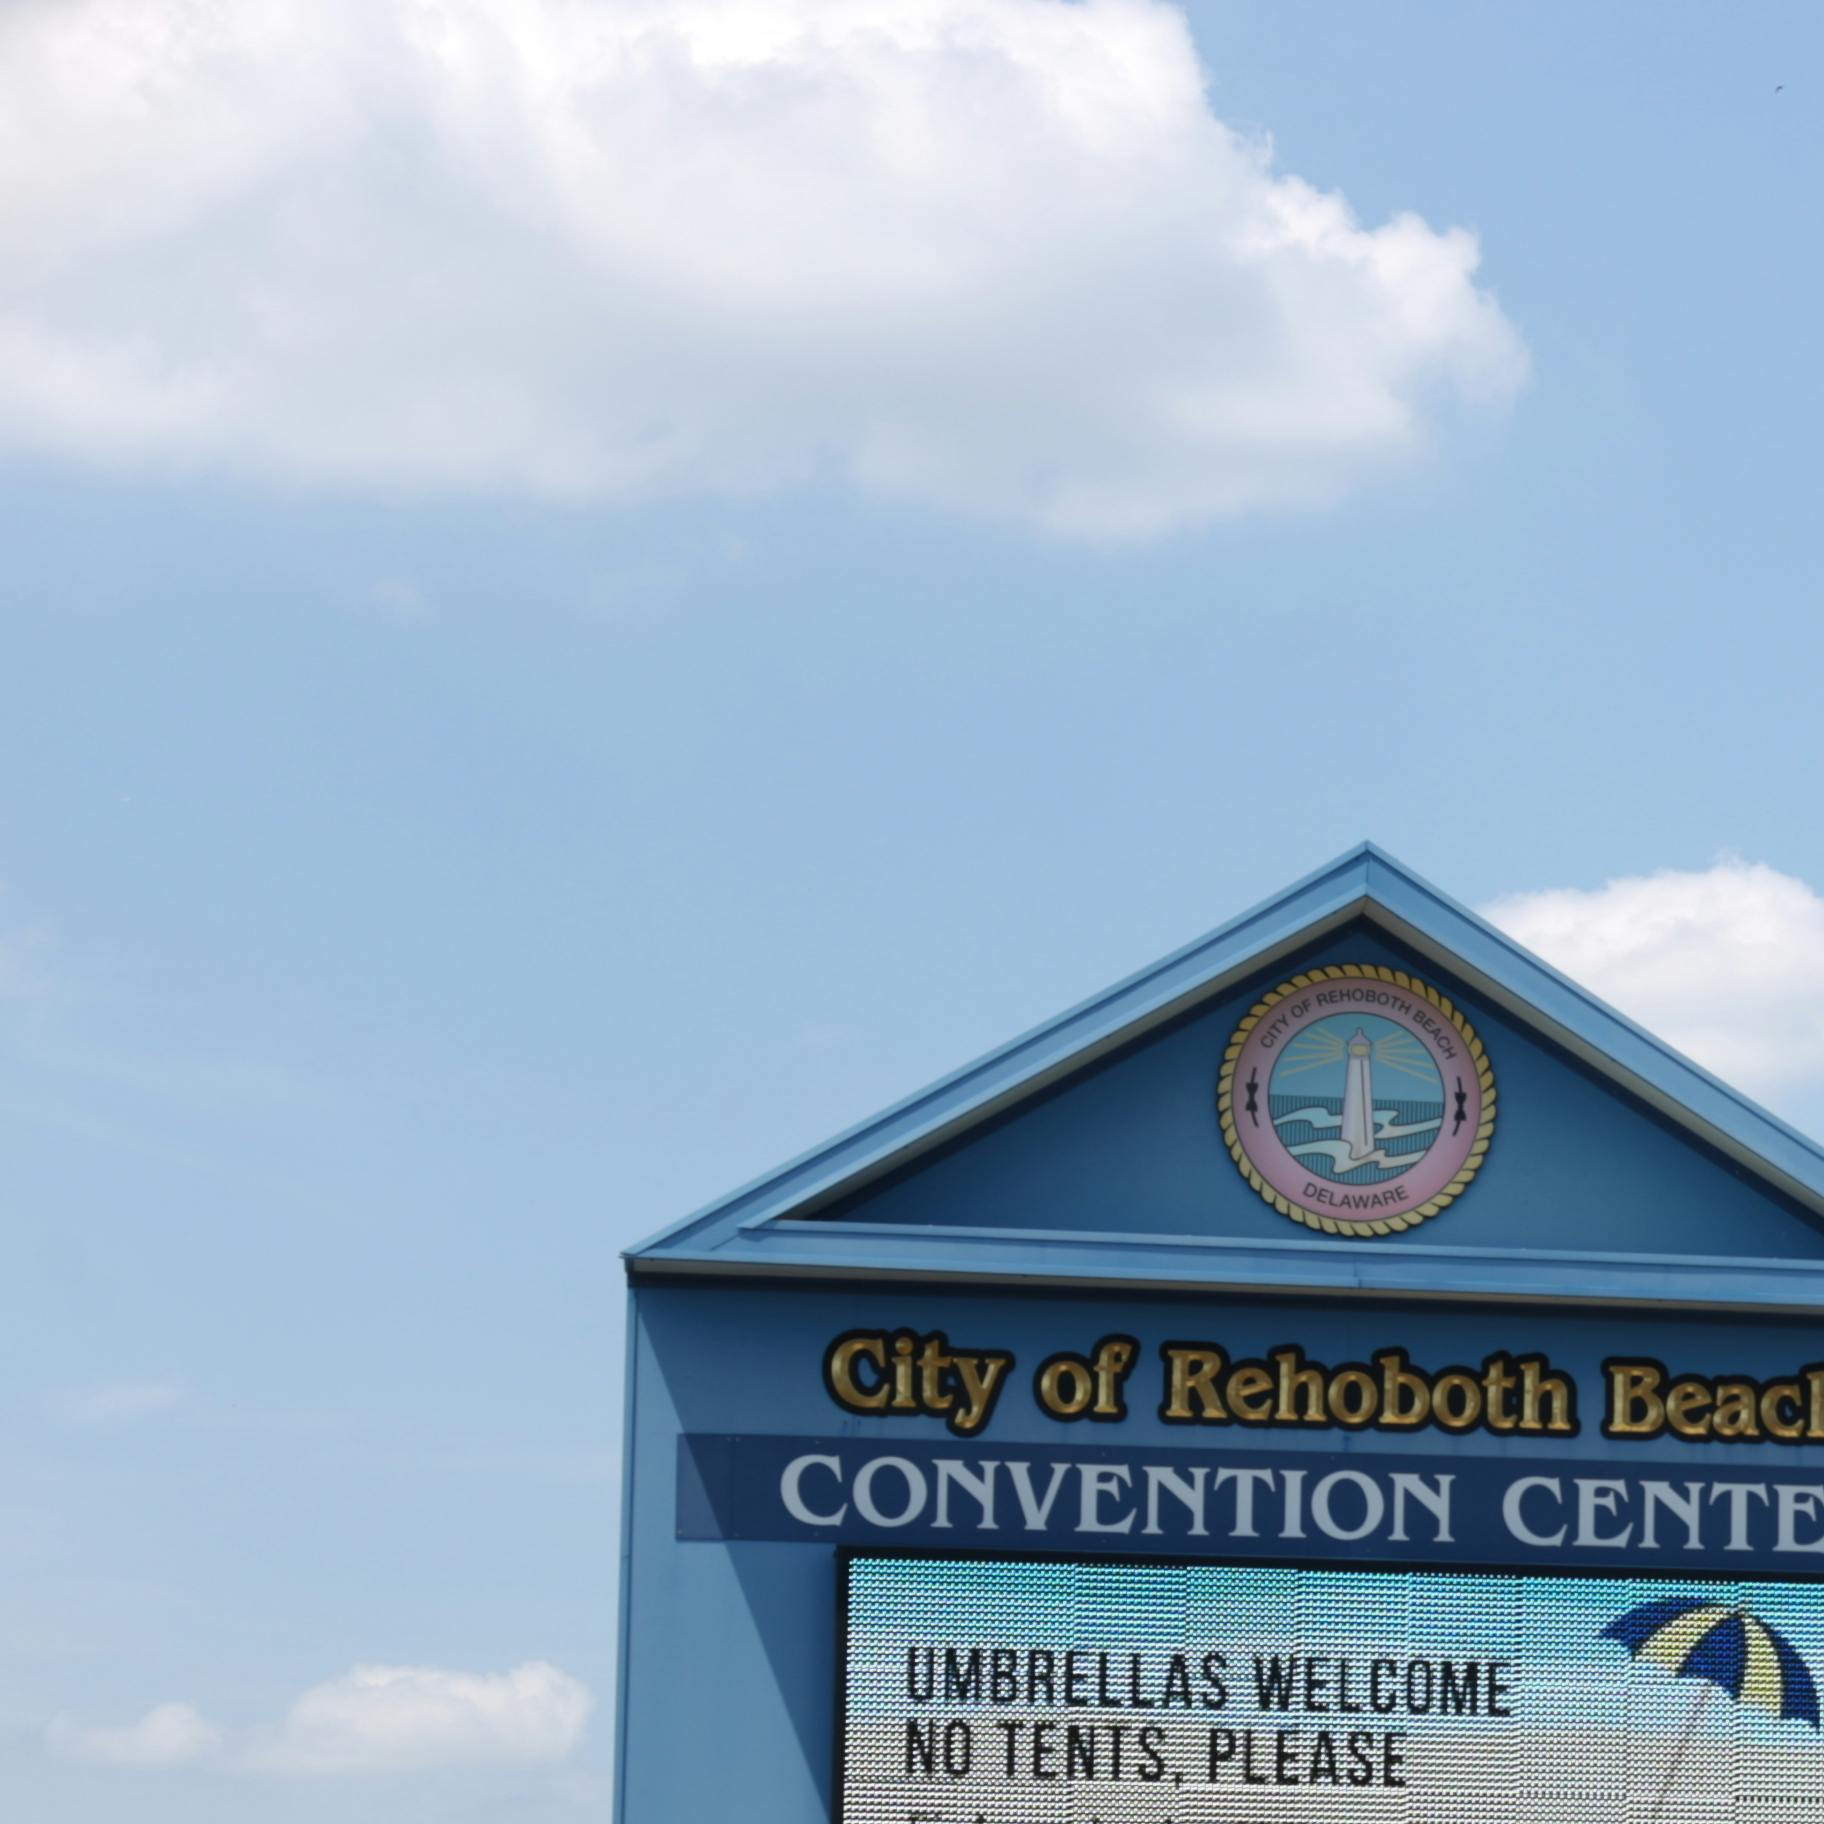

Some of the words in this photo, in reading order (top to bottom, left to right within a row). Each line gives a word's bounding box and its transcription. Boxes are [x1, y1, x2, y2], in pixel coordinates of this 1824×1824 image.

[1260, 1015, 1290, 1049] CITY
[1291, 1000, 1312, 1019] OF
[1316, 988, 1413, 1017] REHOBOTH
[1411, 1010, 1458, 1061] BEACH
[1302, 1182, 1410, 1210] DELAWARE
[828, 1334, 1009, 1431] City
[1038, 1340, 1136, 1416] of
[1163, 1347, 1573, 1432] Rehoboth
[780, 1454, 1456, 1543] CONVENTION
[907, 1646, 1228, 1711] UMBRELLAS
[1253, 1656, 1513, 1717] WELCOME
[905, 1719, 972, 1777] NO
[1002, 1721, 1181, 1790] TENTS,
[1208, 1728, 1407, 1788] PLEASE
